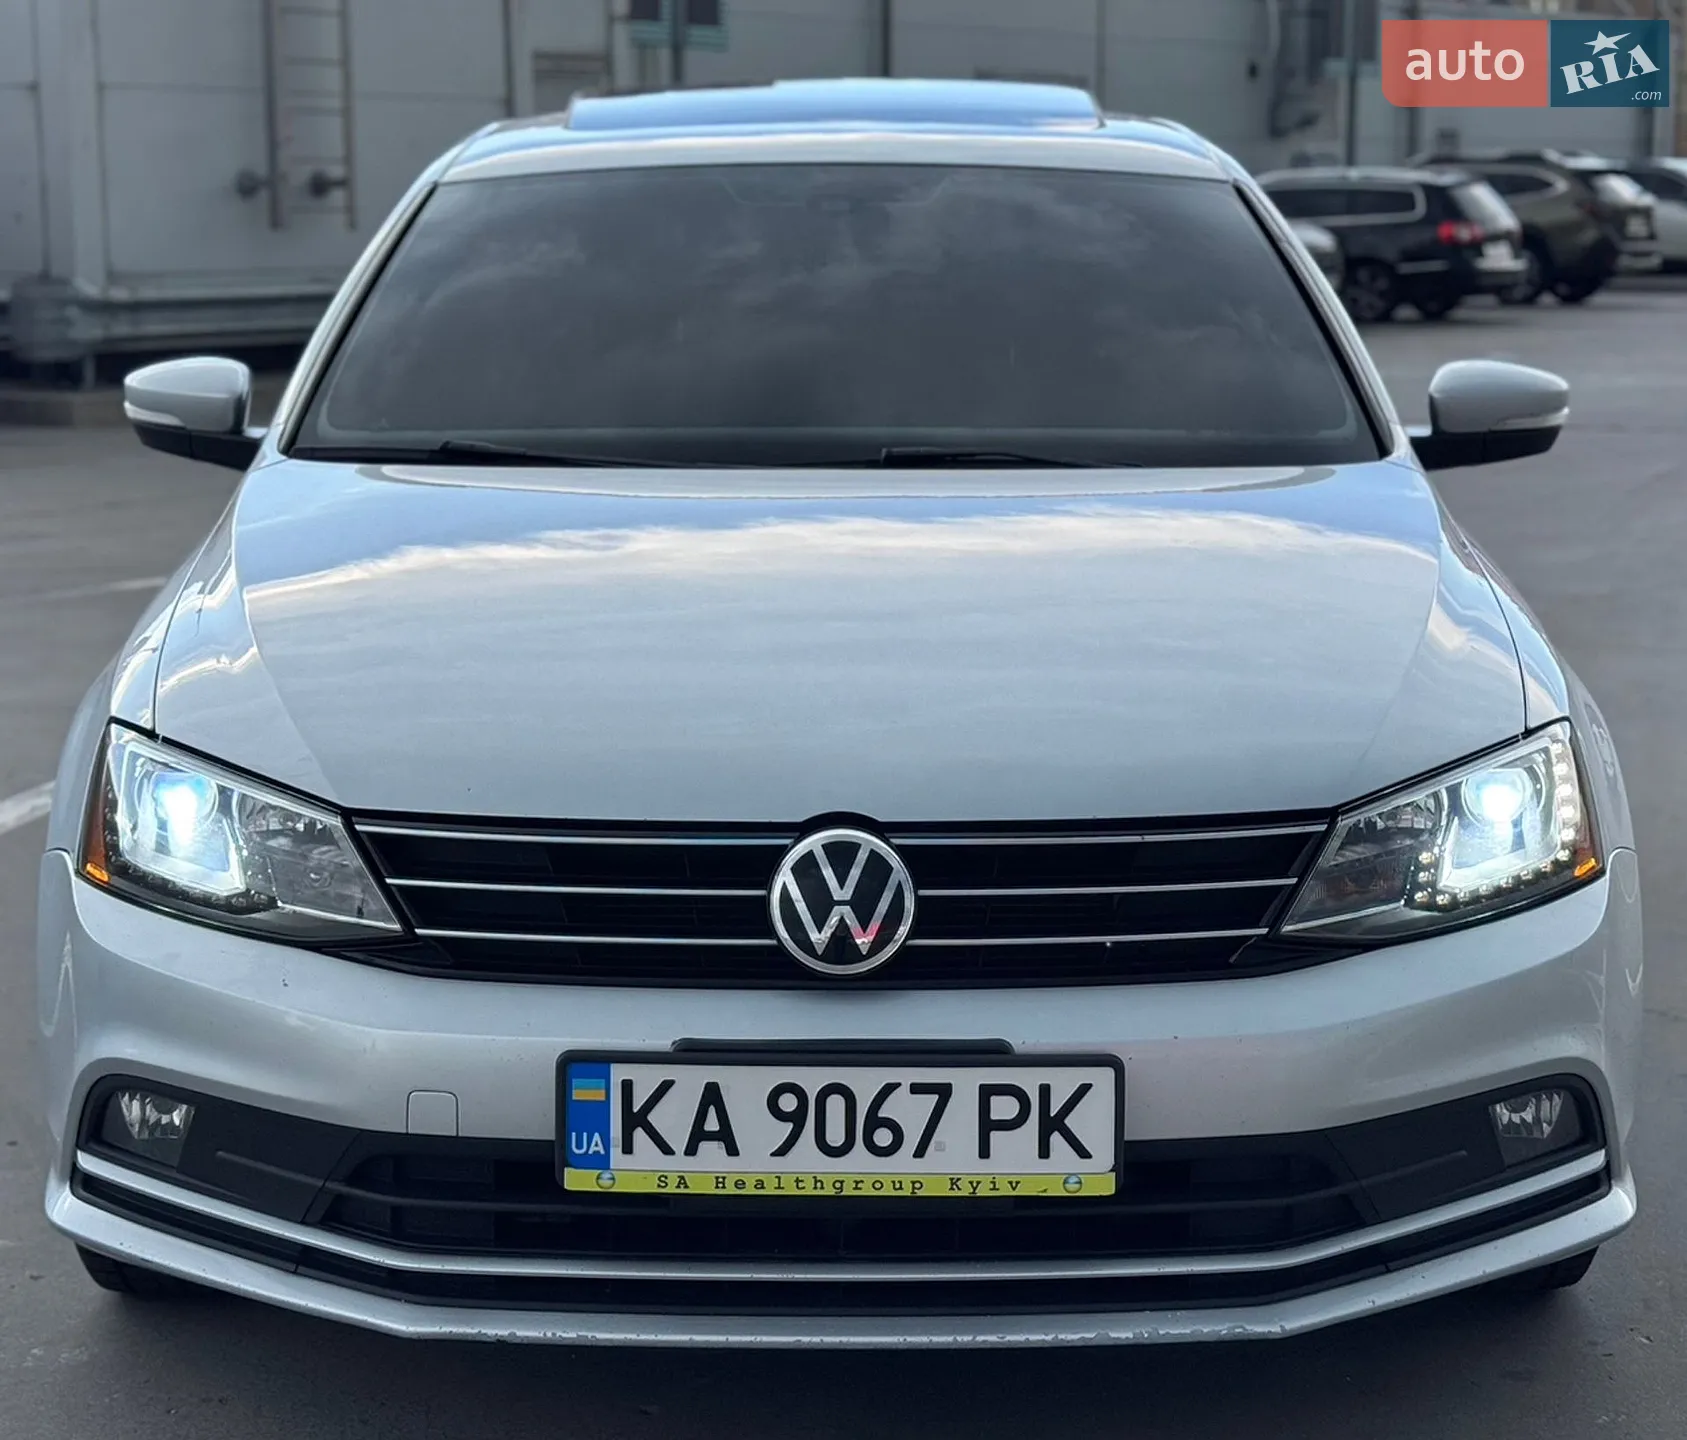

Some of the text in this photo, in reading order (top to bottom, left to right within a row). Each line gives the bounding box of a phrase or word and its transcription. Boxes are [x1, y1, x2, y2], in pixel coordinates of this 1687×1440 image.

[780, 838, 904, 957] VW
[571, 1131, 605, 1156] UA
[620, 1078, 1094, 1160] KA 9067 PK
[656, 1174, 1023, 1195] SA Healthgroup Kyiv
